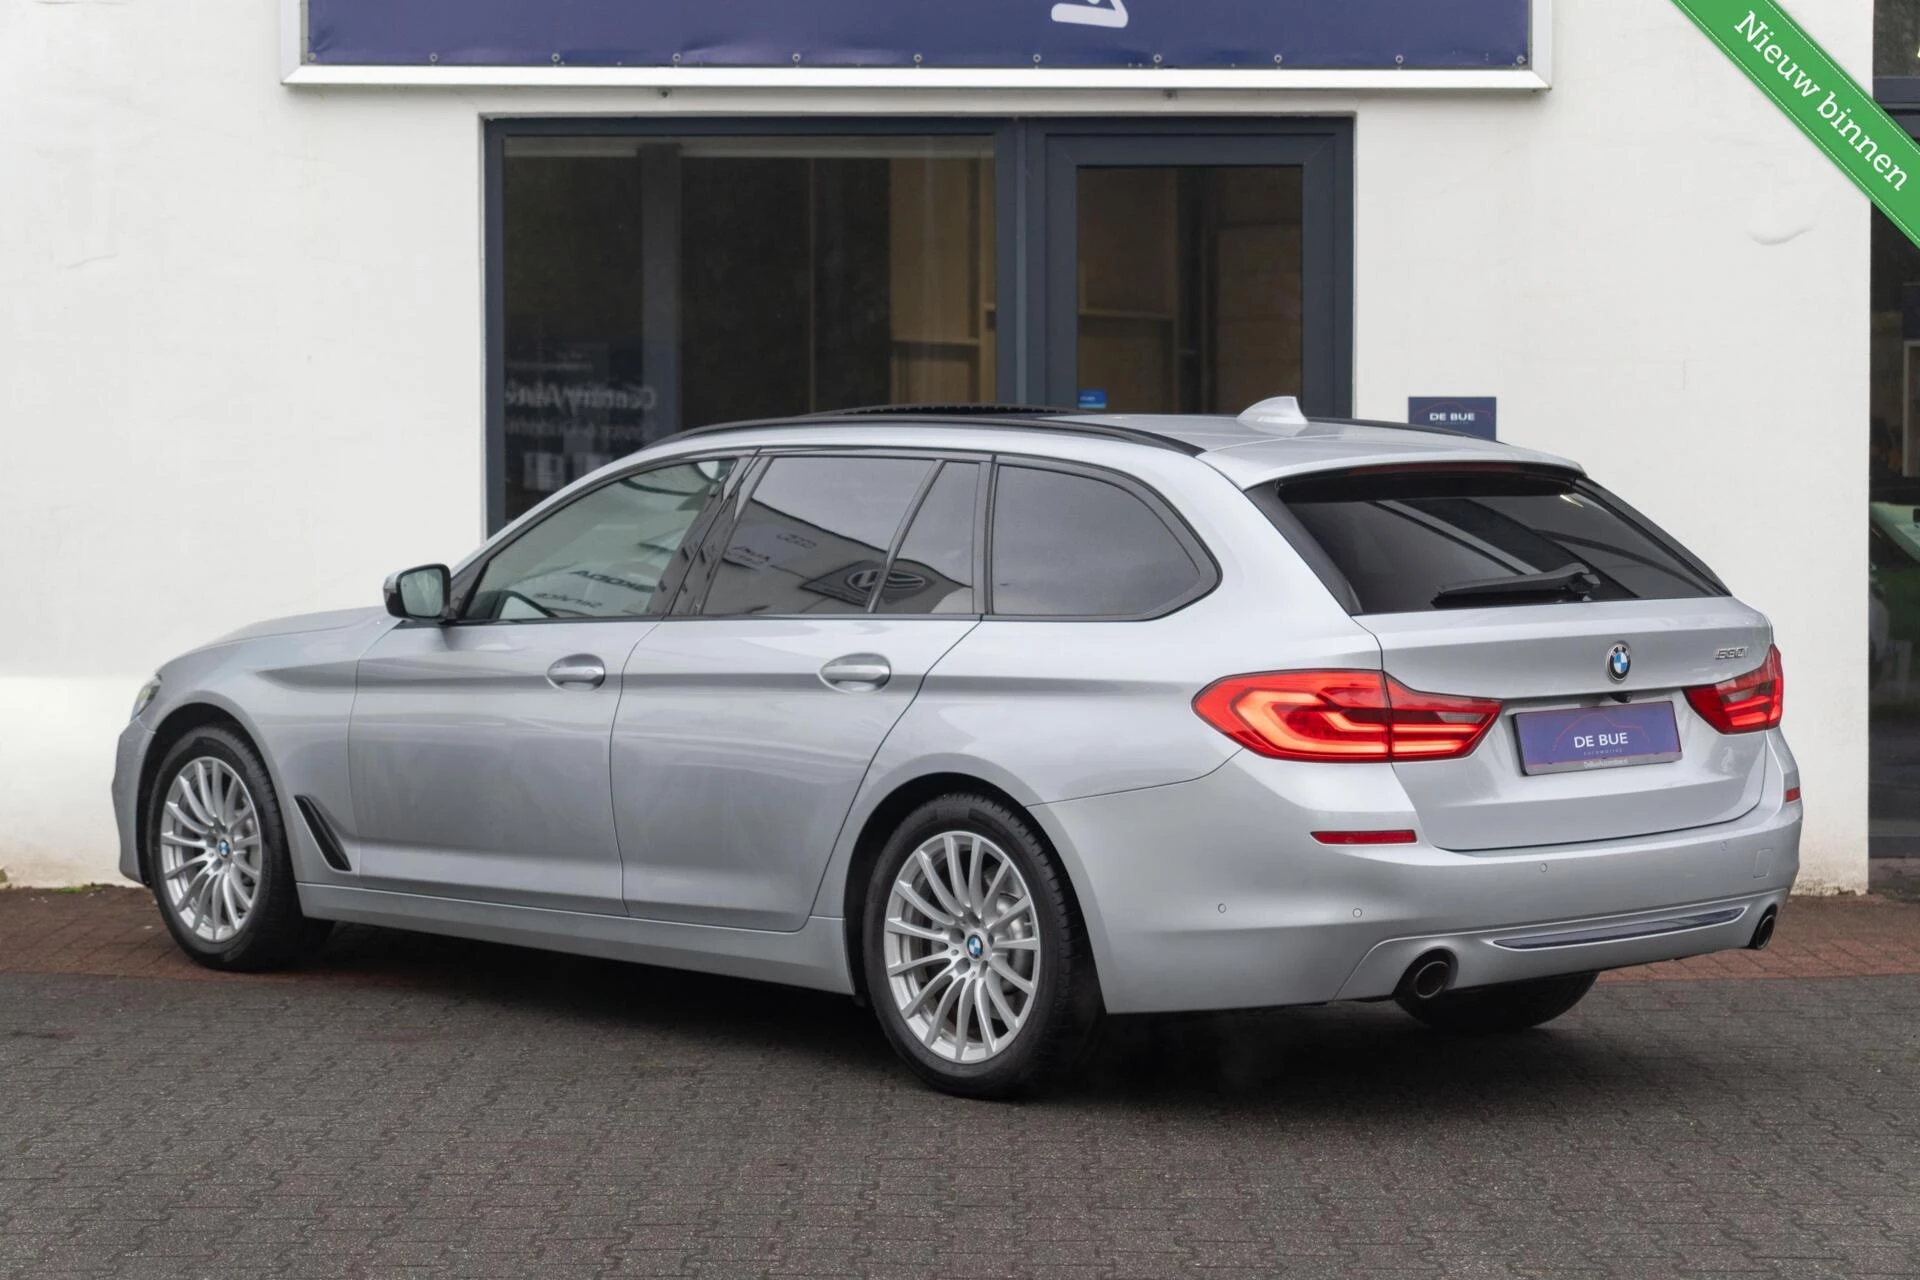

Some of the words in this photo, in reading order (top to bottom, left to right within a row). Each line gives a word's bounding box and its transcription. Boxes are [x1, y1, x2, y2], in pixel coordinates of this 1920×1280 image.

[1429, 412, 1446, 421] DE
[1450, 412, 1476, 421] BUE
[1574, 735, 1595, 748] DE
[1598, 732, 1629, 746] BUE
